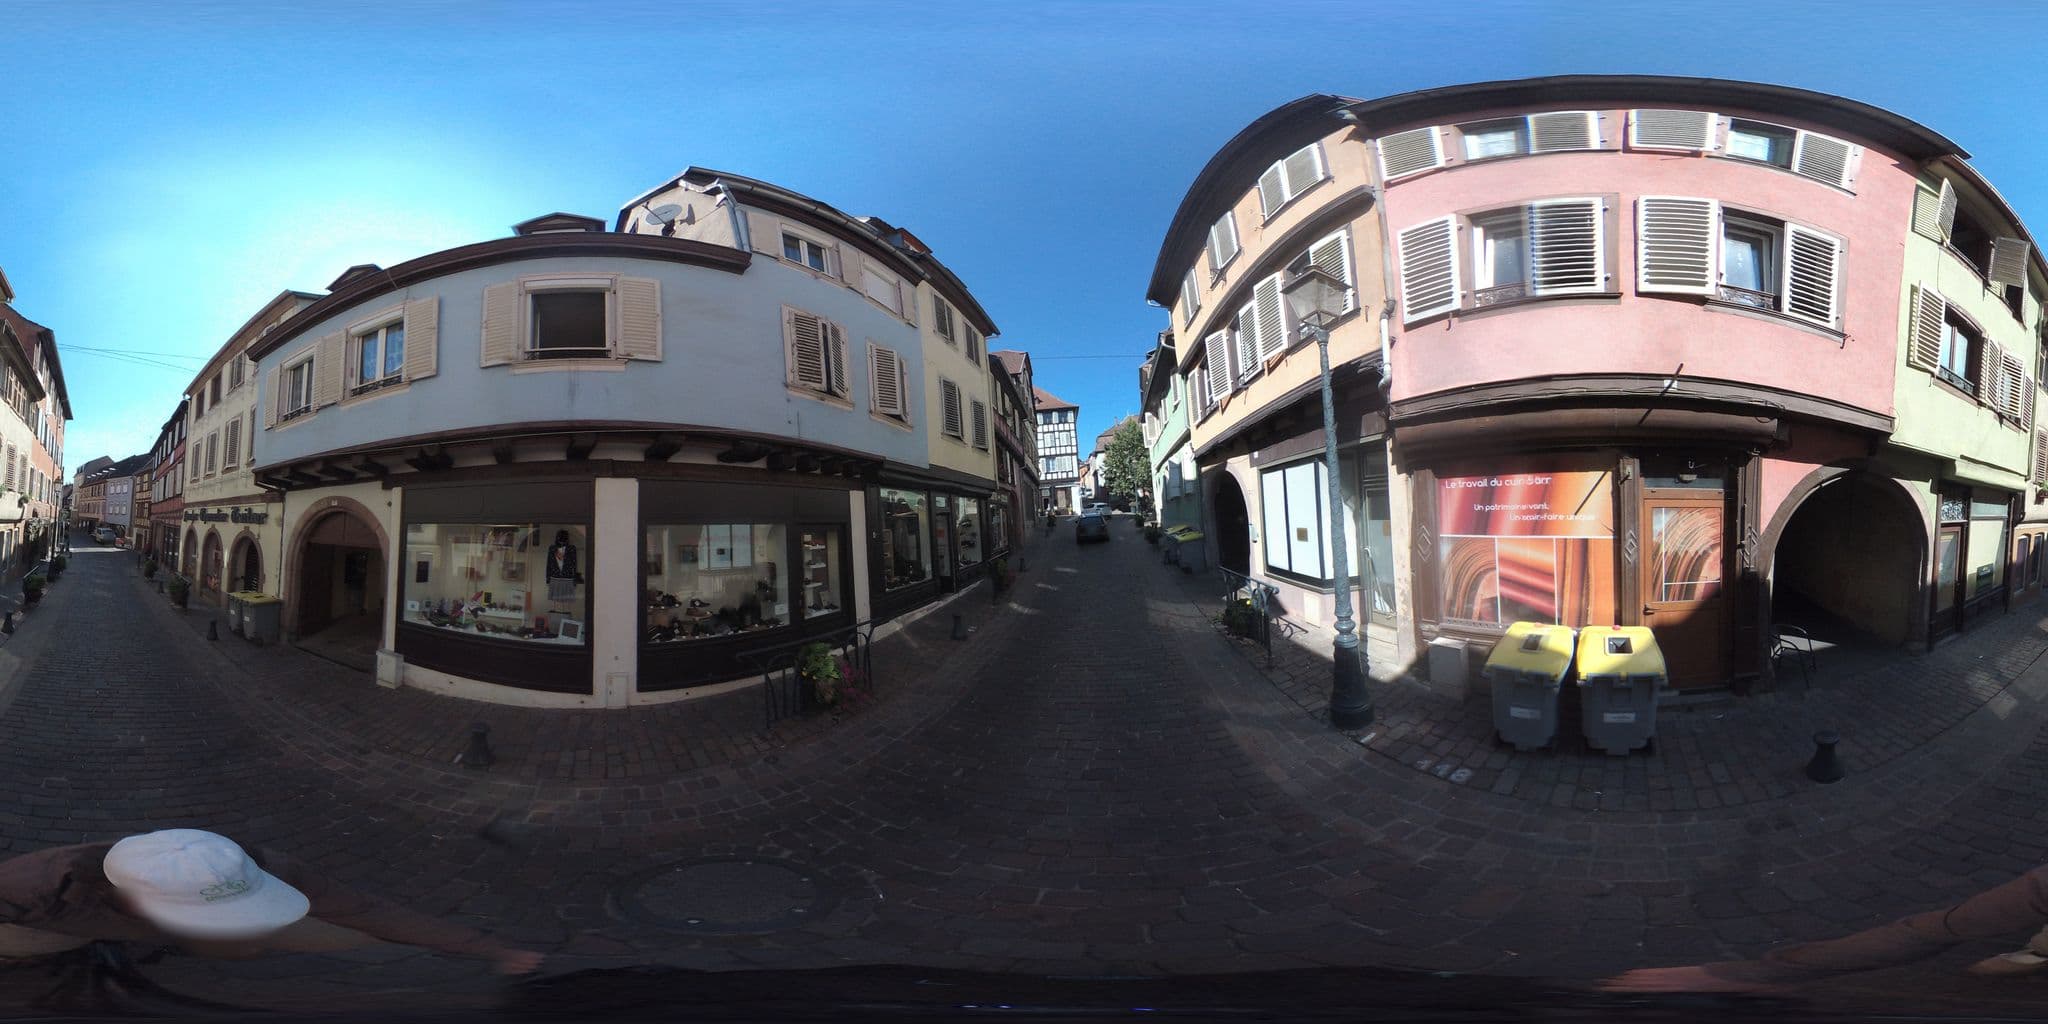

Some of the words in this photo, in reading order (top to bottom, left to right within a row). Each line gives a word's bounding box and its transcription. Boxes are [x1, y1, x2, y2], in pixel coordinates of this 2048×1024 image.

[1445, 479, 1457, 489] Le
[1458, 478, 1488, 488] travail
[1490, 477, 1503, 487] du
[1504, 478, 1524, 487] cuir
[1473, 503, 1485, 511] Un
